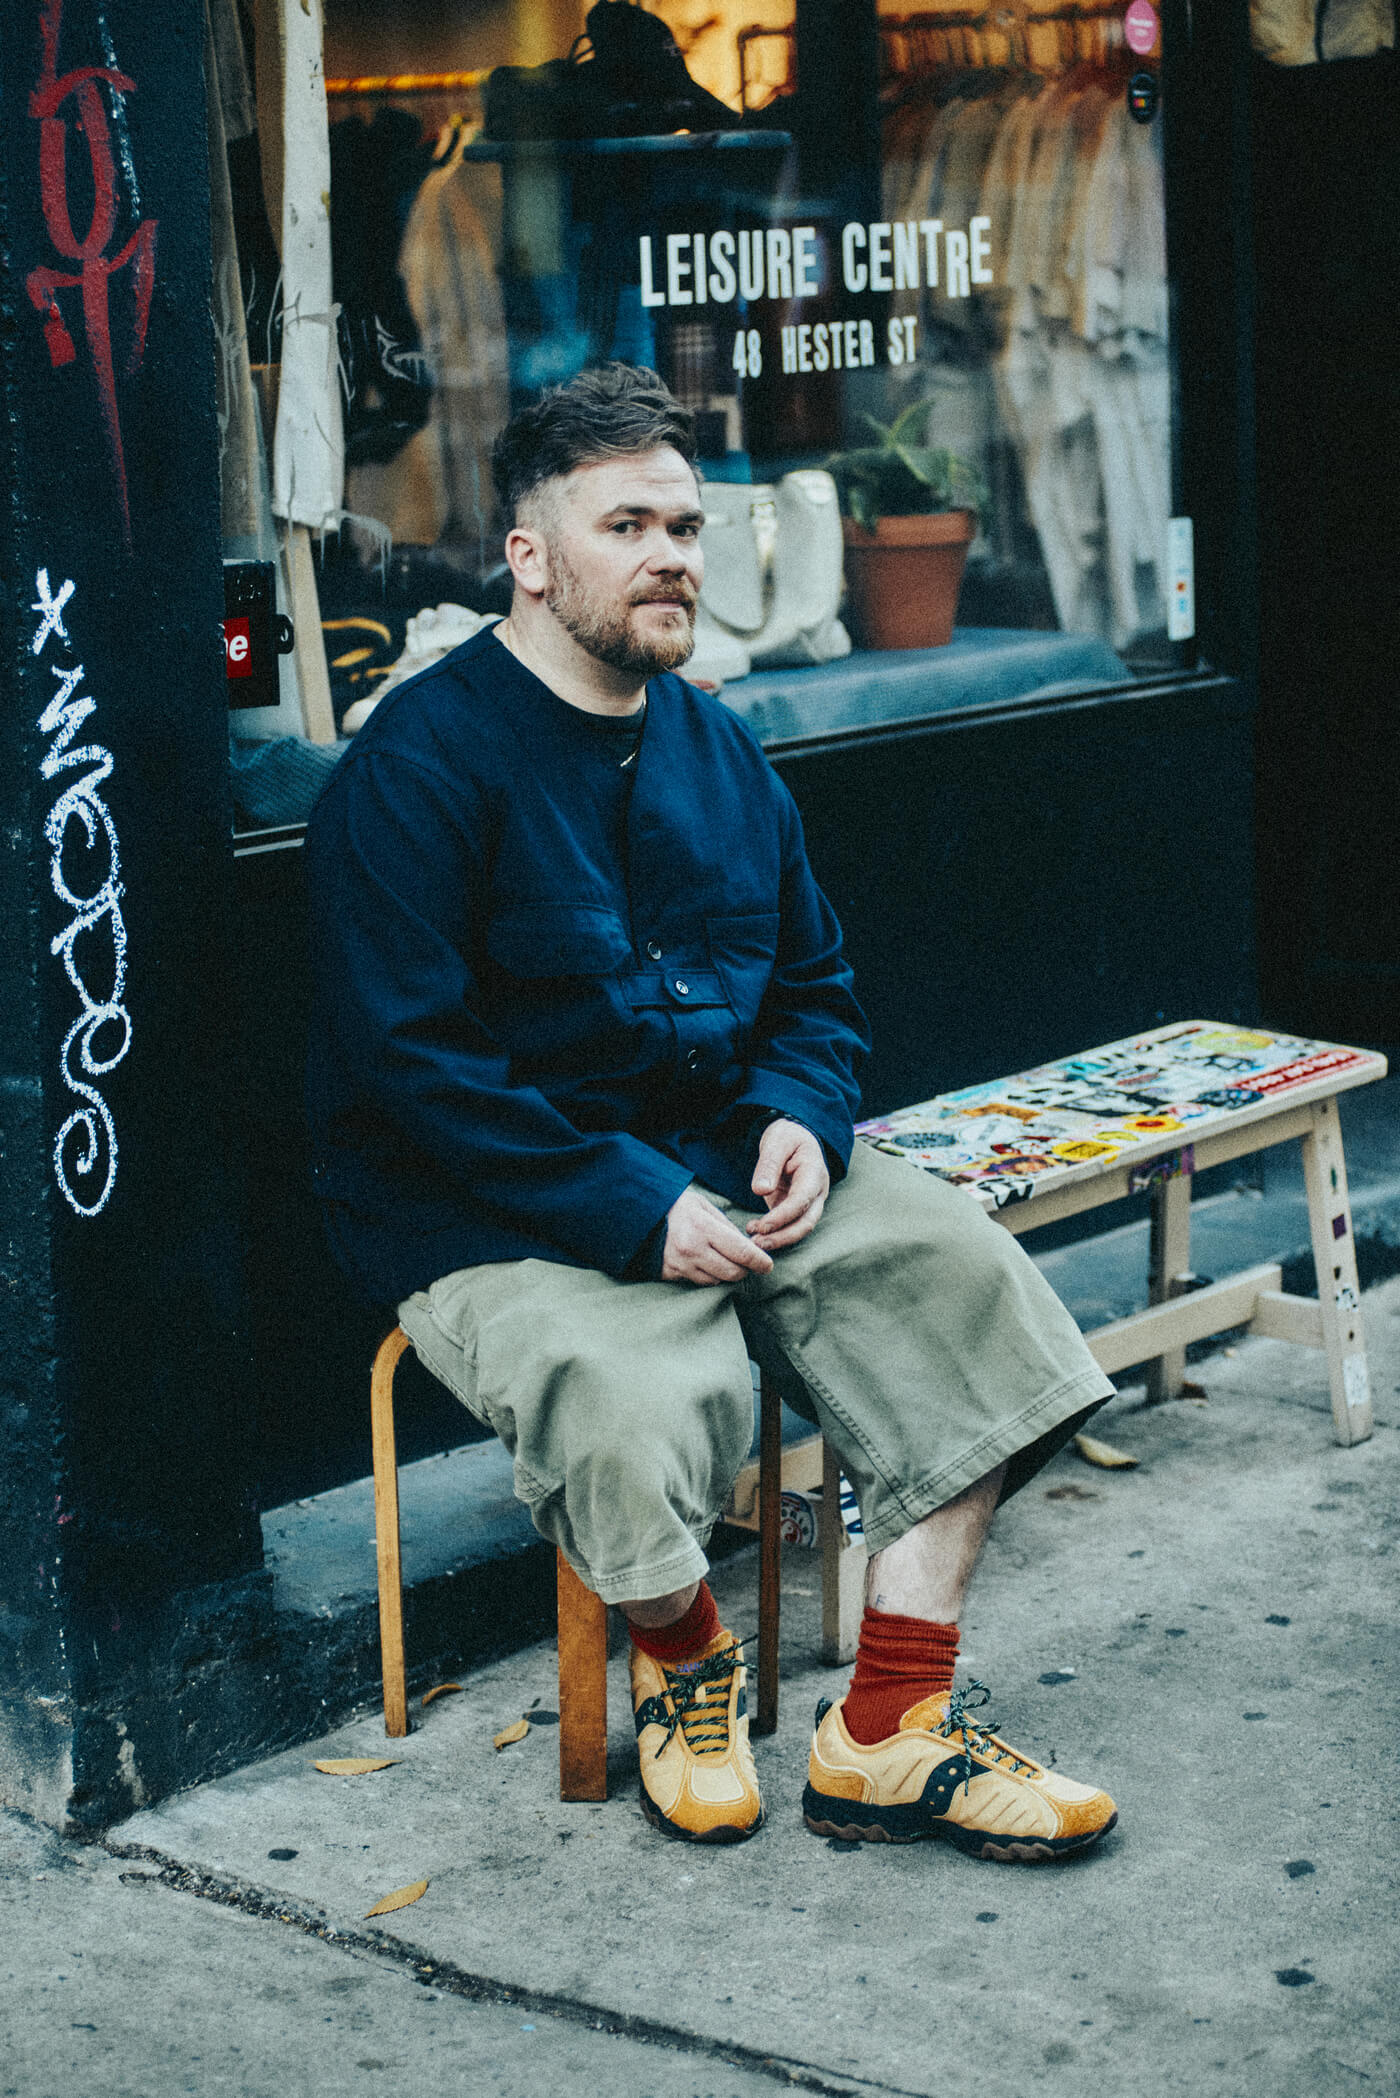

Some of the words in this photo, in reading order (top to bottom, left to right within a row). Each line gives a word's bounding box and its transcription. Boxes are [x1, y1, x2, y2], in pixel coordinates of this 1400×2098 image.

[639, 226, 819, 307] LEISURE
[842, 215, 994, 298] CENTRE
[732, 328, 762, 379] 48
[781, 318, 876, 375] HESTER
[887, 315, 919, 367] ST
